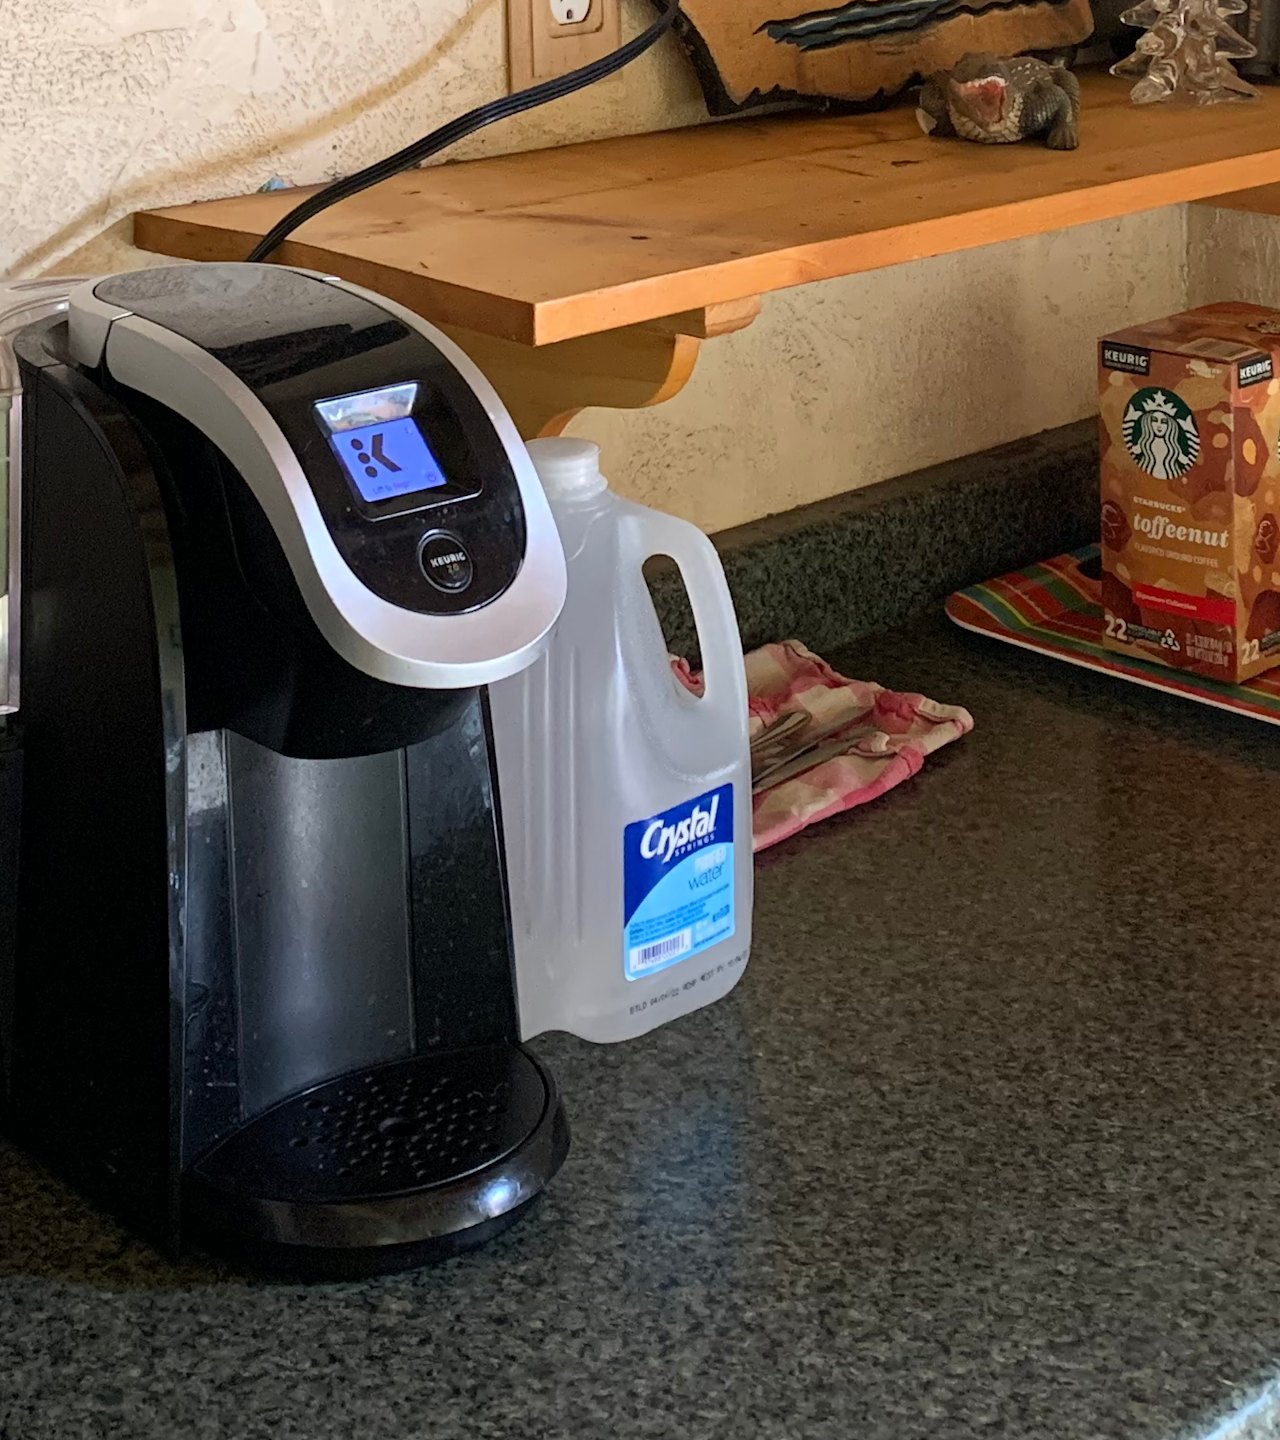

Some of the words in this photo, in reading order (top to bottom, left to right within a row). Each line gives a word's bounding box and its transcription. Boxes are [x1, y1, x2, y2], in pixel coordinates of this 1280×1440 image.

[1104, 349, 1149, 367] KEURIG
[1239, 360, 1272, 379] KEURIG
[1133, 512, 1230, 549] toffeenut
[429, 551, 466, 568] KEURIG
[1104, 614, 1128, 641] 22
[1241, 638, 1260, 666] 22
[640, 793, 720, 865] Crystal
[674, 832, 715, 857] SPRINGS
[687, 862, 726, 891] water
